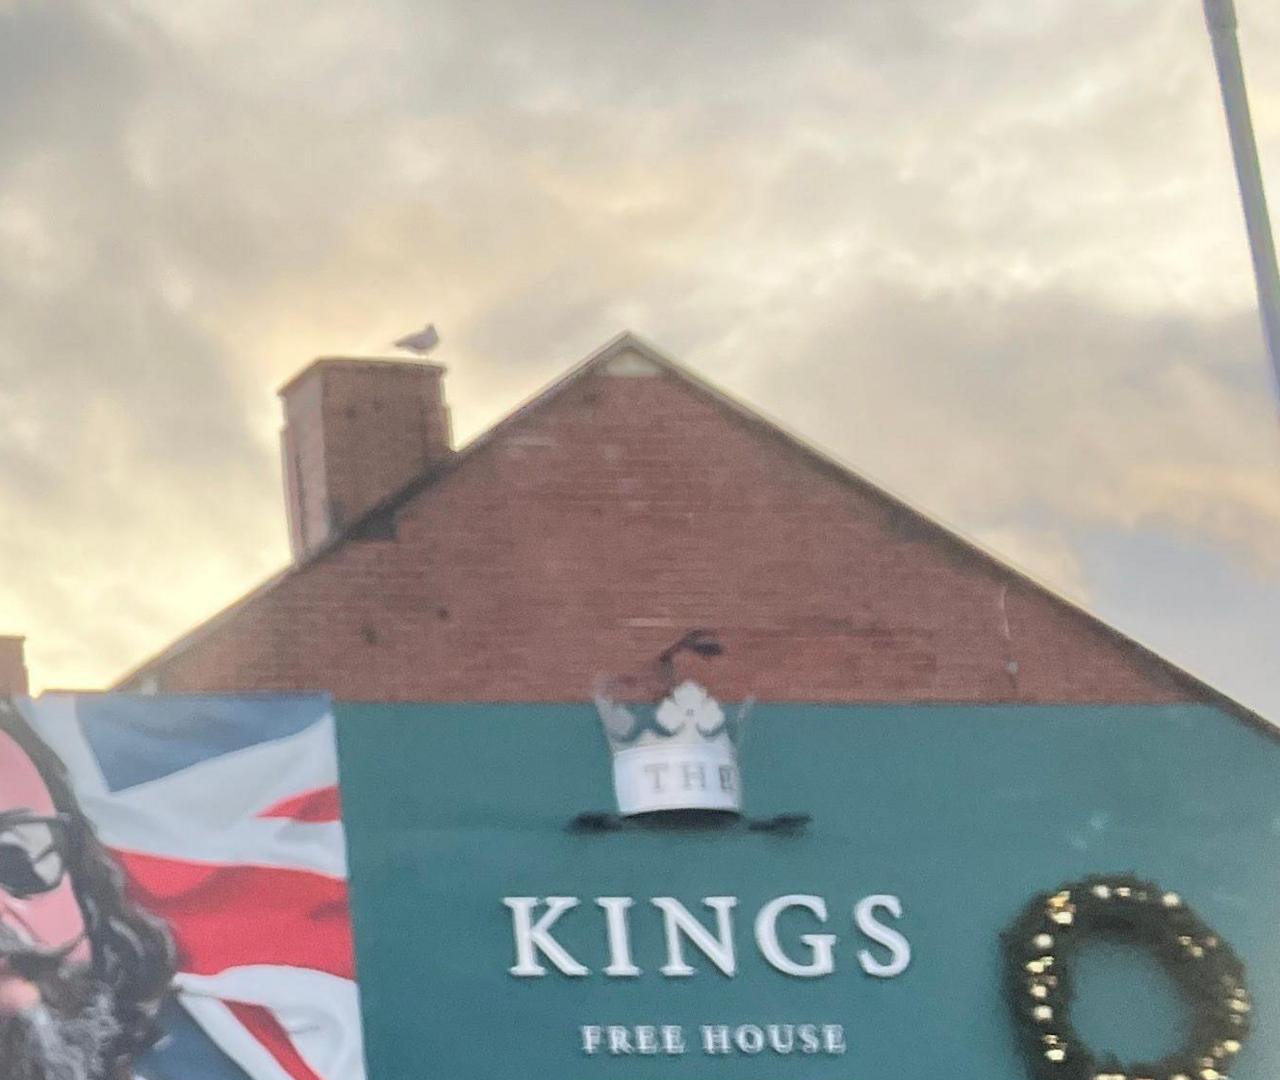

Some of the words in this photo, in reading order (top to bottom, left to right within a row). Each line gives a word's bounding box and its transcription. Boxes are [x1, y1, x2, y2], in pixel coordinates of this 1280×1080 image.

[642, 761, 737, 791] THE
[503, 893, 912, 977] KINGS
[582, 1023, 685, 1054] FREE
[702, 1023, 846, 1054] HOUSE
